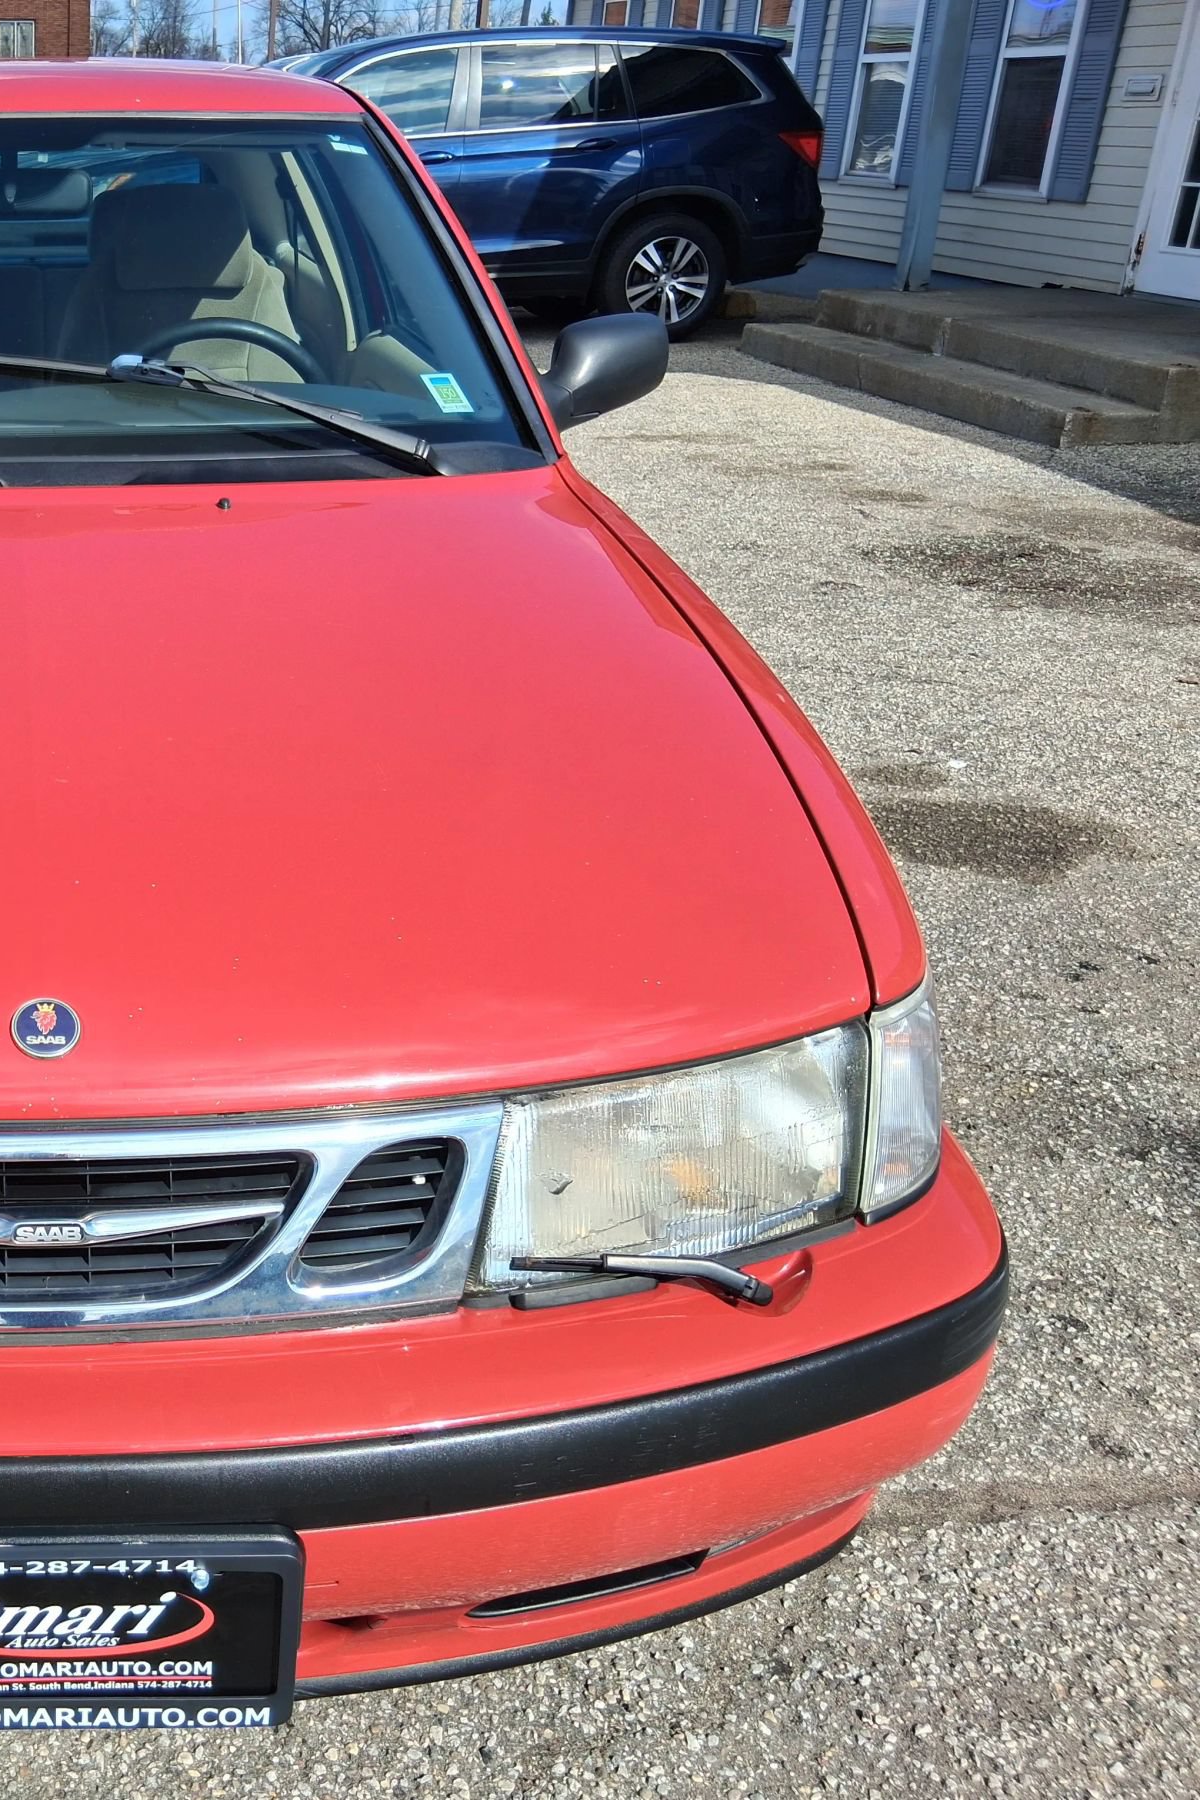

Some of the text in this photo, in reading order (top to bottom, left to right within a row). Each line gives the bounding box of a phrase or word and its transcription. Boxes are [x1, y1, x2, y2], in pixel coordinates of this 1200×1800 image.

[26, 1035, 66, 1045] SAAB
[16, 1226, 81, 1242] SAAB
[4, 1633, 120, 1649] Auto Sales
[11, 1683, 27, 1691] St.
[29, 1682, 61, 1691] South
[137, 1680, 213, 1689] 574-287-4714
